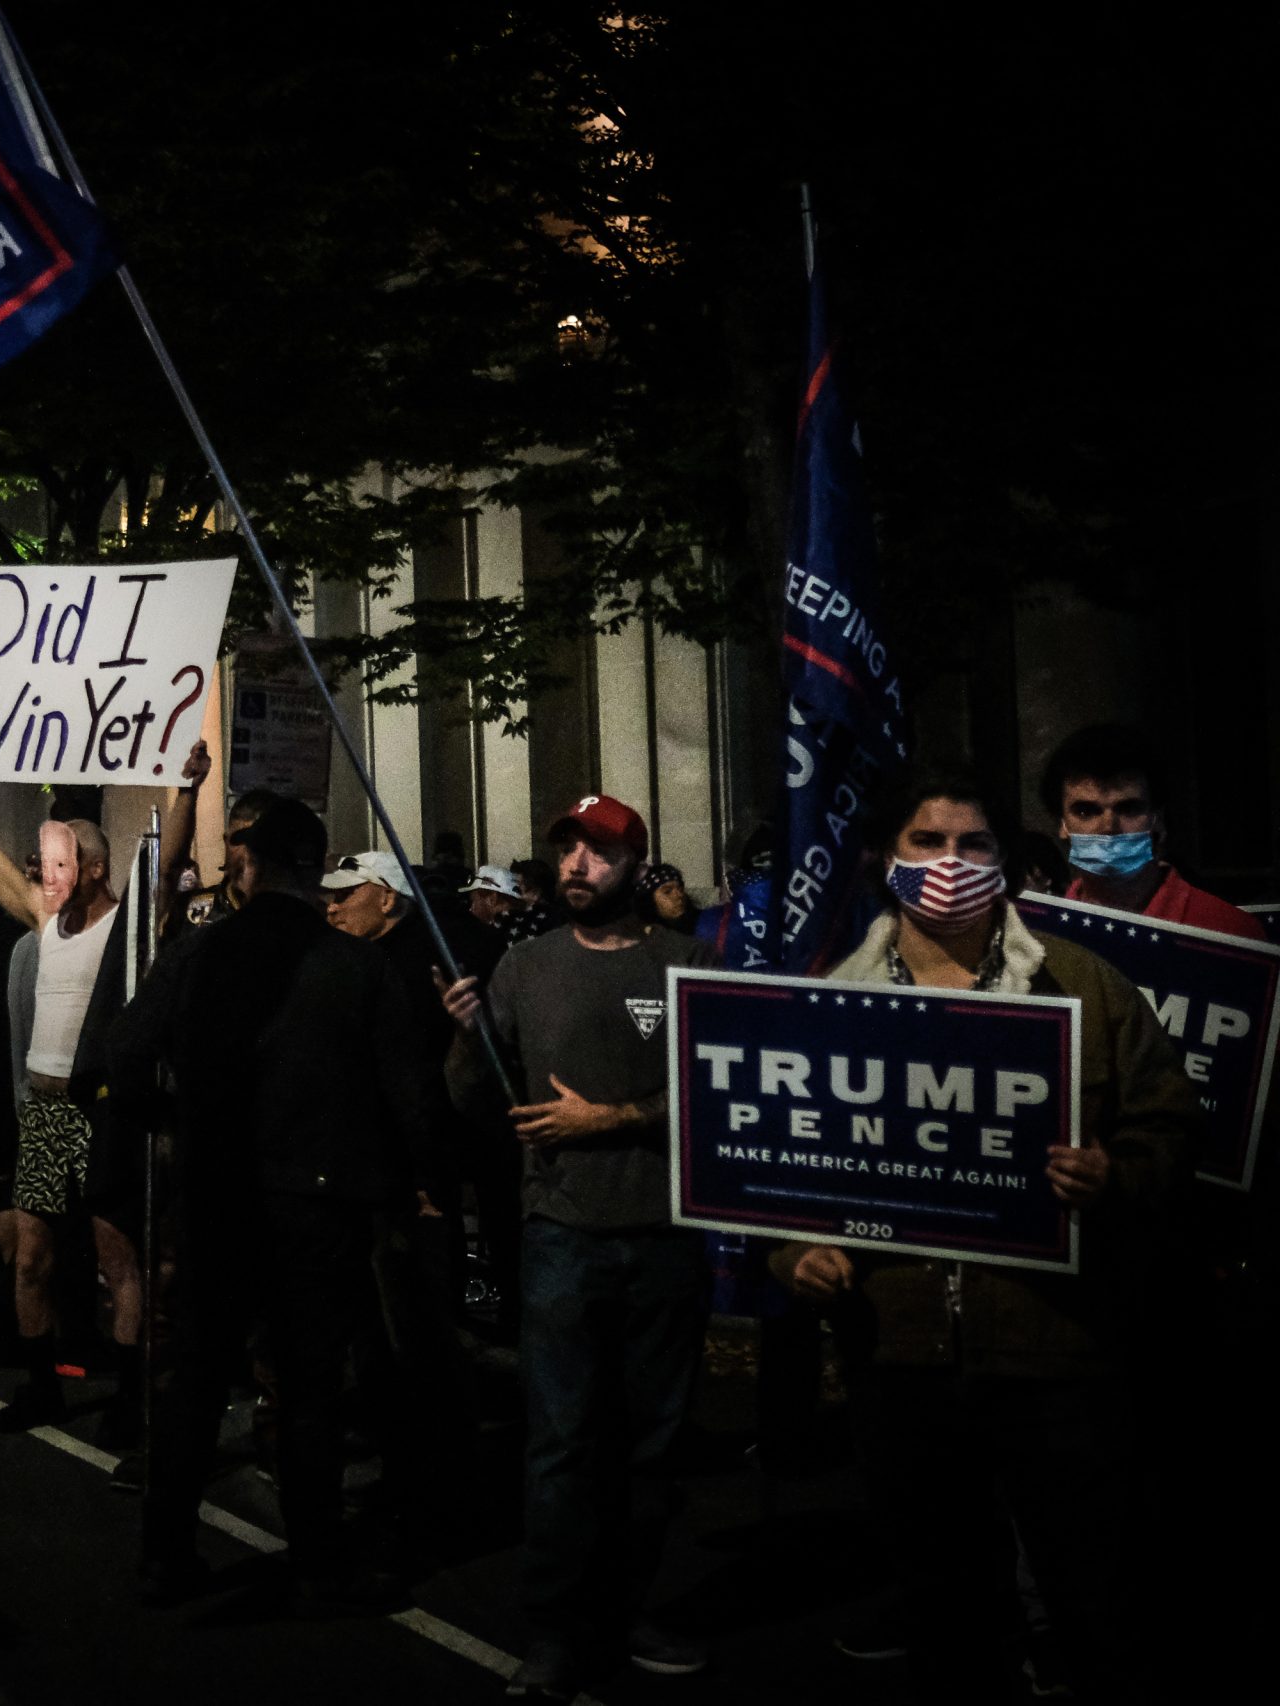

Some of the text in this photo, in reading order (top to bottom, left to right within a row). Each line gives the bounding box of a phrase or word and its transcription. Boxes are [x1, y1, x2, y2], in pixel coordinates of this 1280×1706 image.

[99, 573, 168, 669] I
[785, 561, 887, 678] EEPING
[696, 1043, 1049, 1117] TRUMP
[730, 1103, 1014, 1159] PENCE
[717, 1144, 1027, 1190] MAKE AMERICA GREAT AGAIN!
[844, 1220, 894, 1239] 2020
